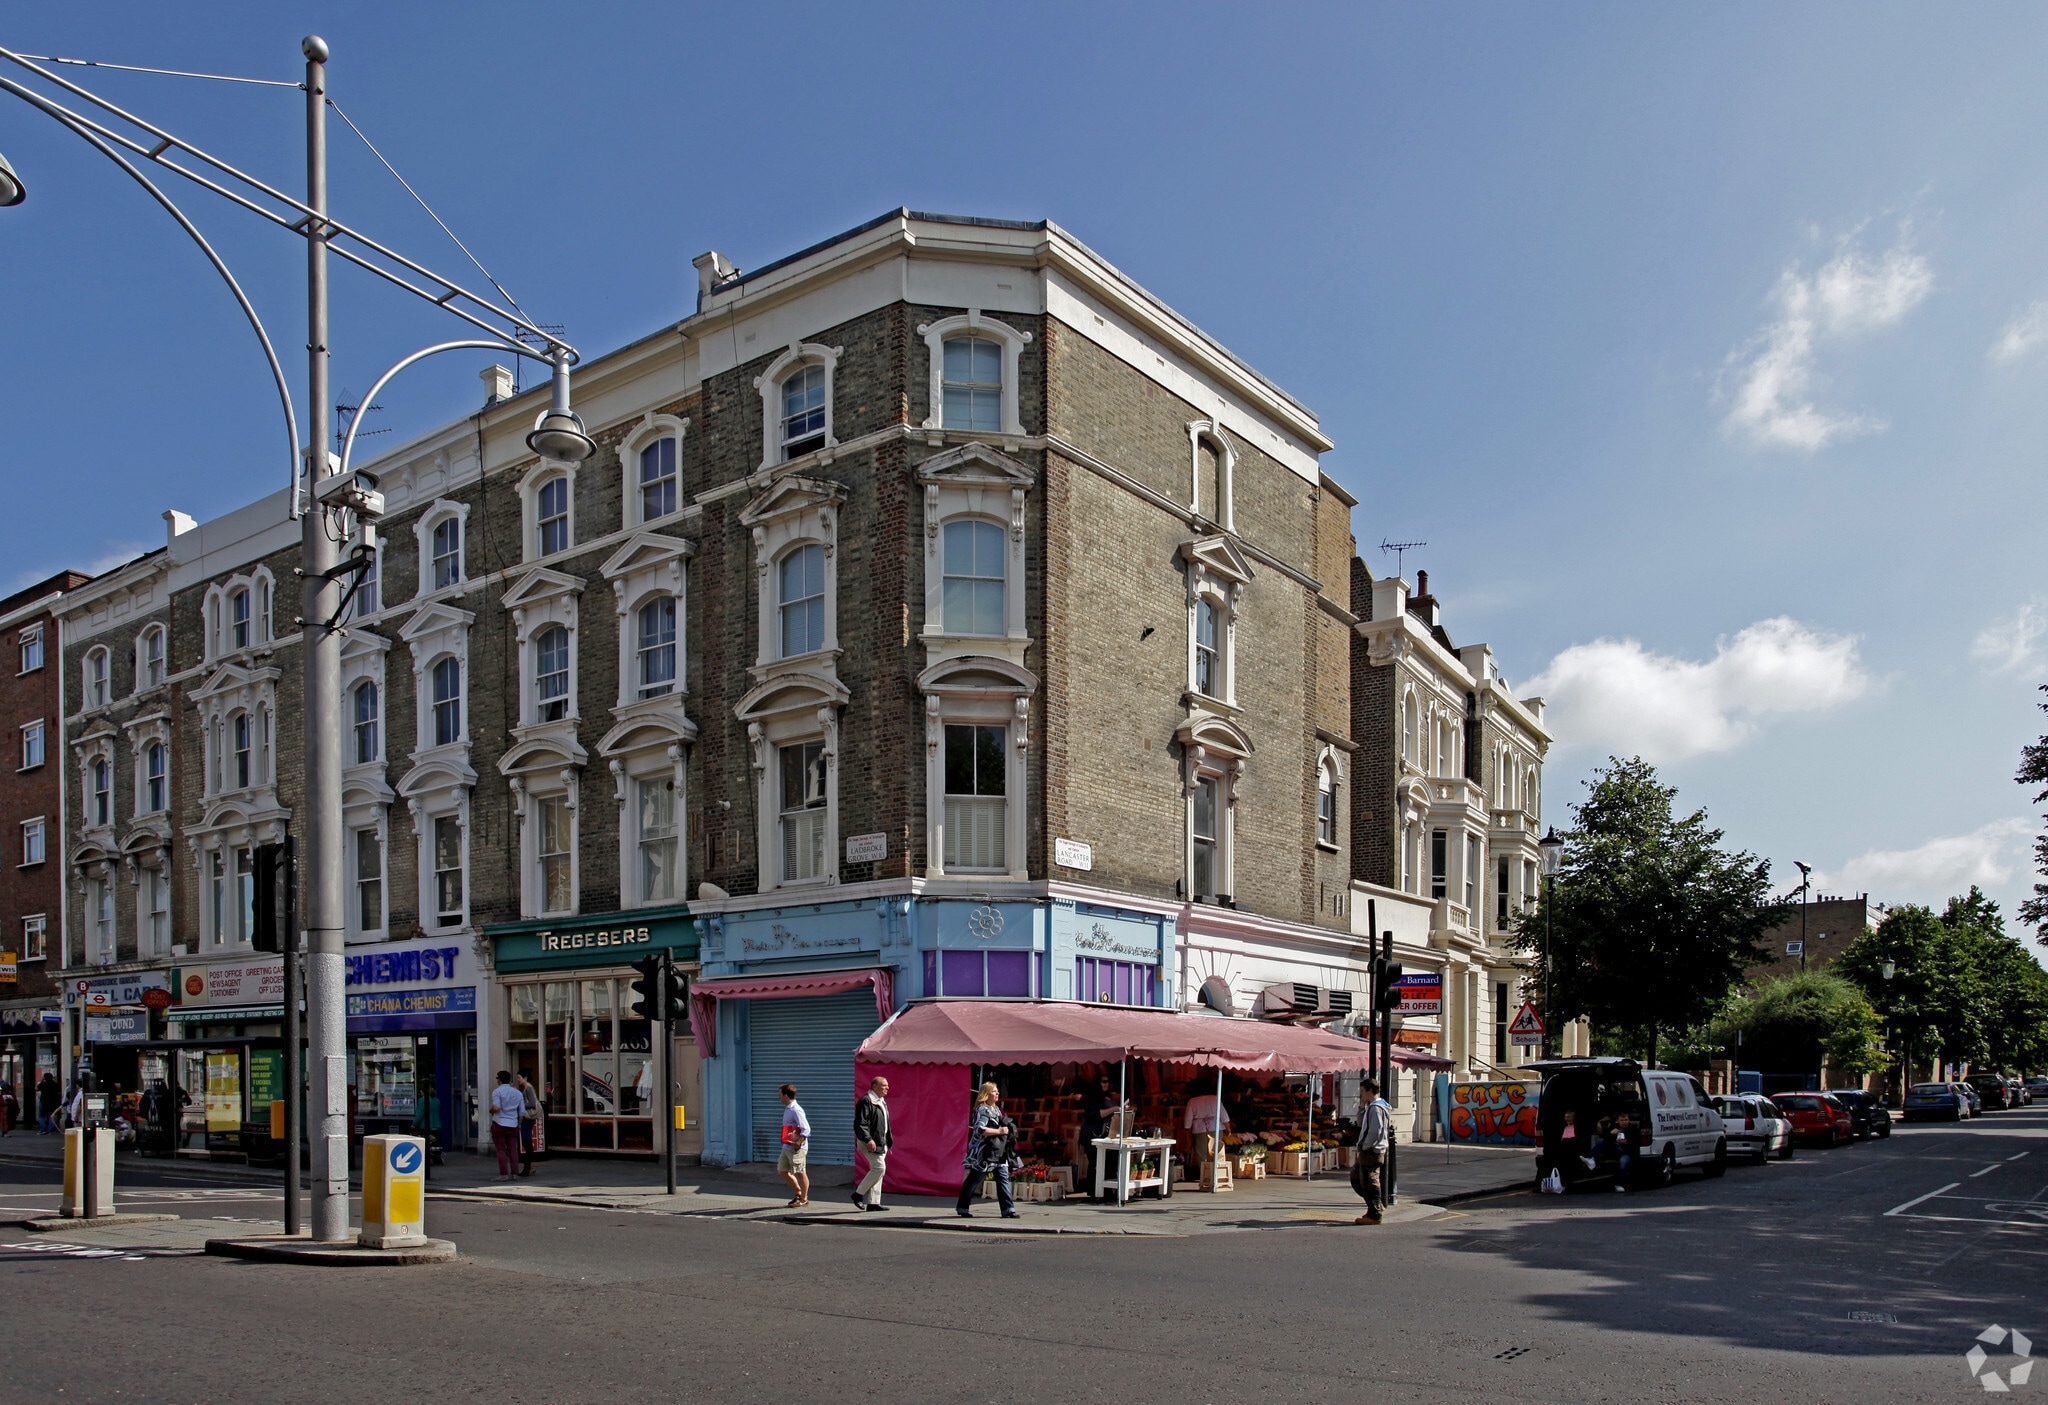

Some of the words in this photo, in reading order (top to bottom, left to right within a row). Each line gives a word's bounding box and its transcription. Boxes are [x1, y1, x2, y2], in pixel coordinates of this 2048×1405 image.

[851, 845, 883, 854] LADBROKE
[1057, 850, 1089, 862] LANCASTER
[1058, 857, 1073, 865] ROAD
[536, 927, 649, 951] TREGESERS
[246, 967, 272, 976] GREETING
[210, 979, 241, 988] NEWSAGENT
[1407, 975, 1439, 984] Barnard
[81, 982, 86, 990] B
[210, 988, 240, 997] STATIONERY
[259, 986, 269, 994] OFF
[368, 998, 401, 1012] CHANA
[404, 995, 448, 1010] CHEMIST
[112, 1018, 135, 1030] OUND
[1657, 1113, 1665, 1122] The
